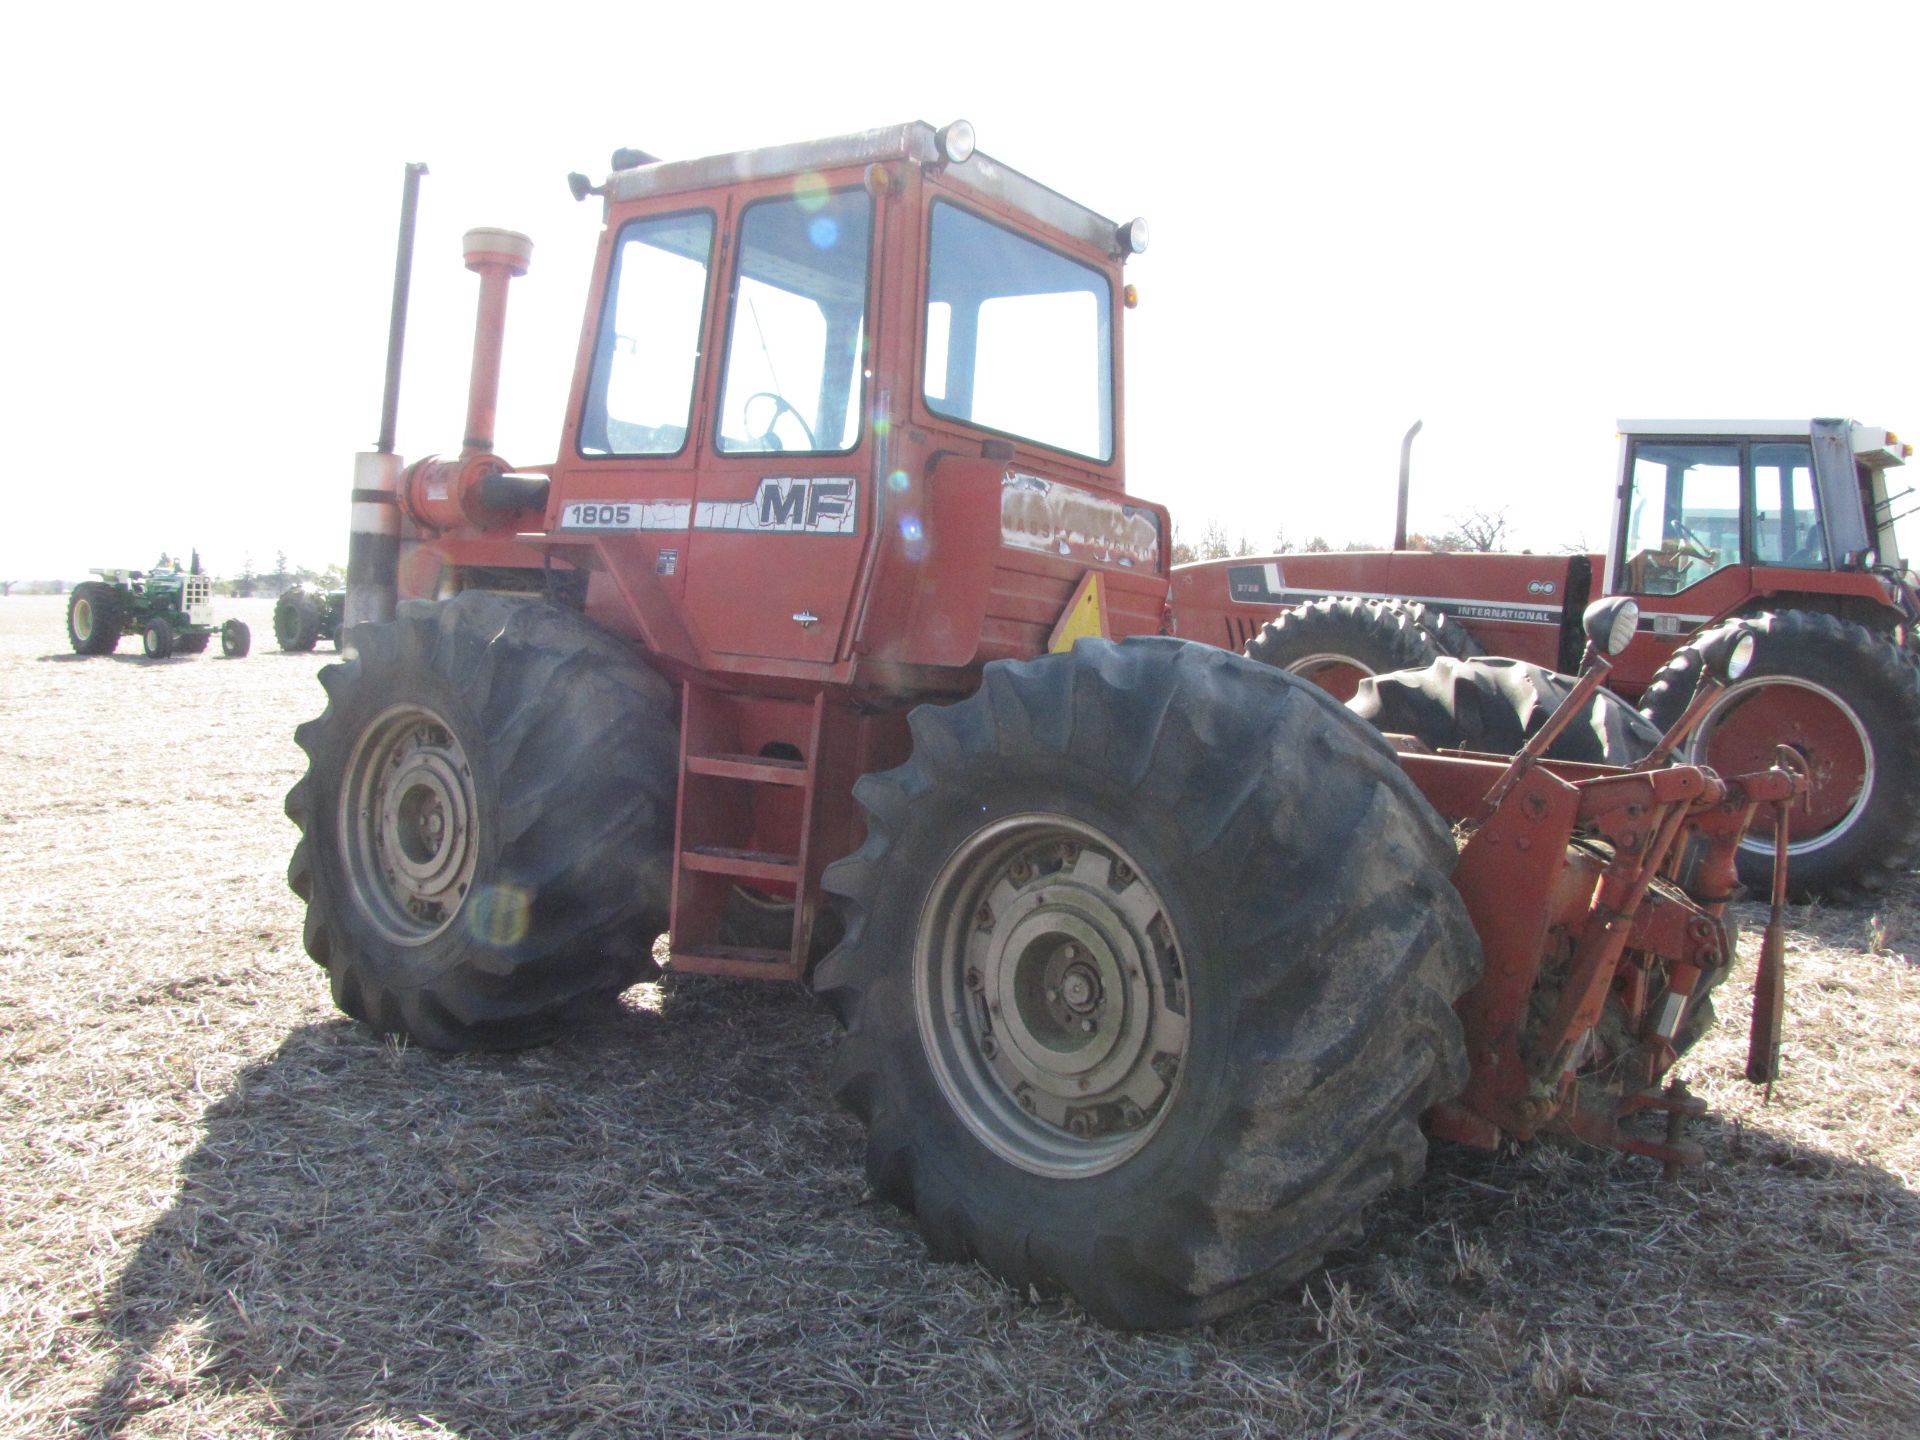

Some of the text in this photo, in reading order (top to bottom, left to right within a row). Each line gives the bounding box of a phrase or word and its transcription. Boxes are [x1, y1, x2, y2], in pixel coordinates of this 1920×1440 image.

[572, 505, 631, 525] 1805
[760, 484, 850, 527] MF
[1458, 606, 1550, 621] INTERNATIONAL
